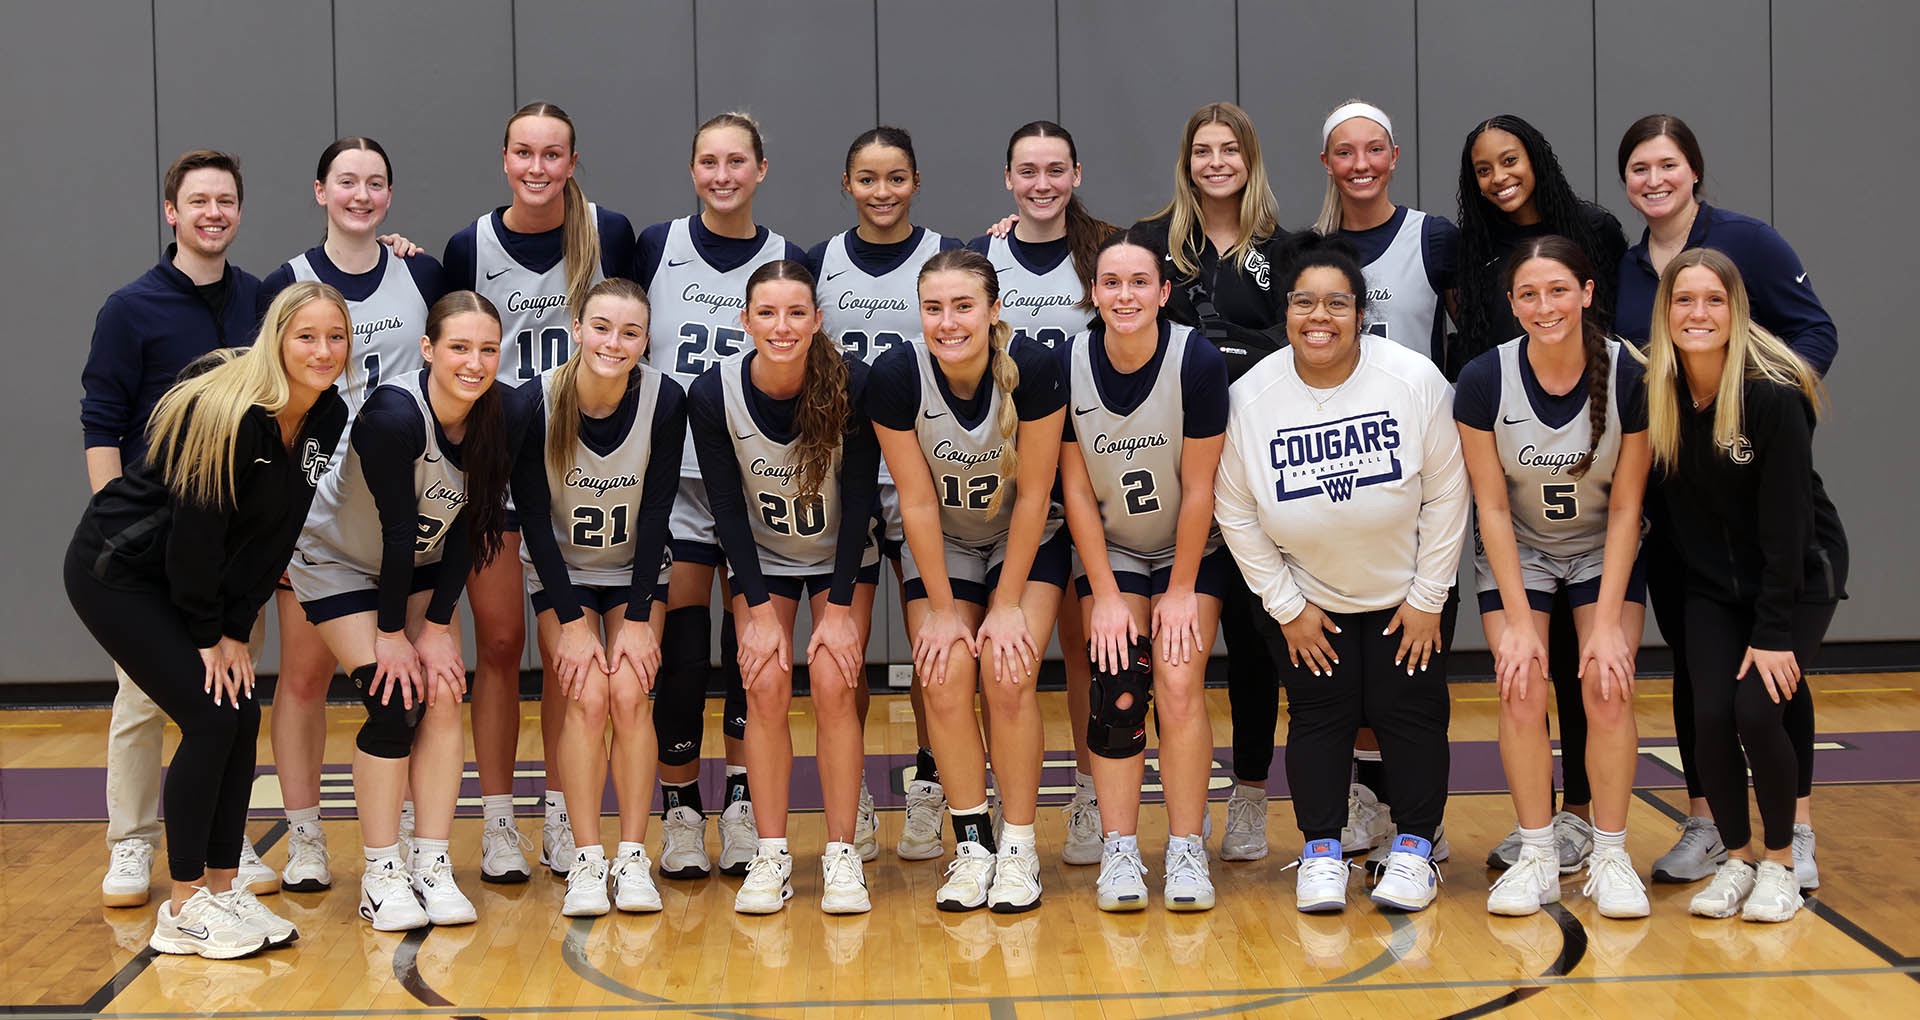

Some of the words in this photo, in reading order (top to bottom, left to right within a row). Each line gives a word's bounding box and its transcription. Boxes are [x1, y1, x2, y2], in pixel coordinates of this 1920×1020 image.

[507, 289, 572, 319] Cougar
[681, 282, 747, 316] Cougar
[839, 289, 909, 320] Cougars
[1002, 288, 1075, 317] Cougars
[352, 315, 404, 345] ugars
[515, 326, 570, 381] 10
[673, 321, 747, 377] 25
[361, 352, 382, 401] 1
[1093, 432, 1169, 462] Cougars
[1269, 418, 1401, 470] COUGARS
[1517, 443, 1599, 476] Cougar
[564, 466, 641, 498] Cougars
[1292, 456, 1382, 478] BASKETBALL
[941, 473, 1001, 511] 12
[1119, 467, 1162, 517] 2
[1541, 482, 1579, 522] 5
[571, 503, 630, 549] 21
[757, 491, 828, 538] 20
